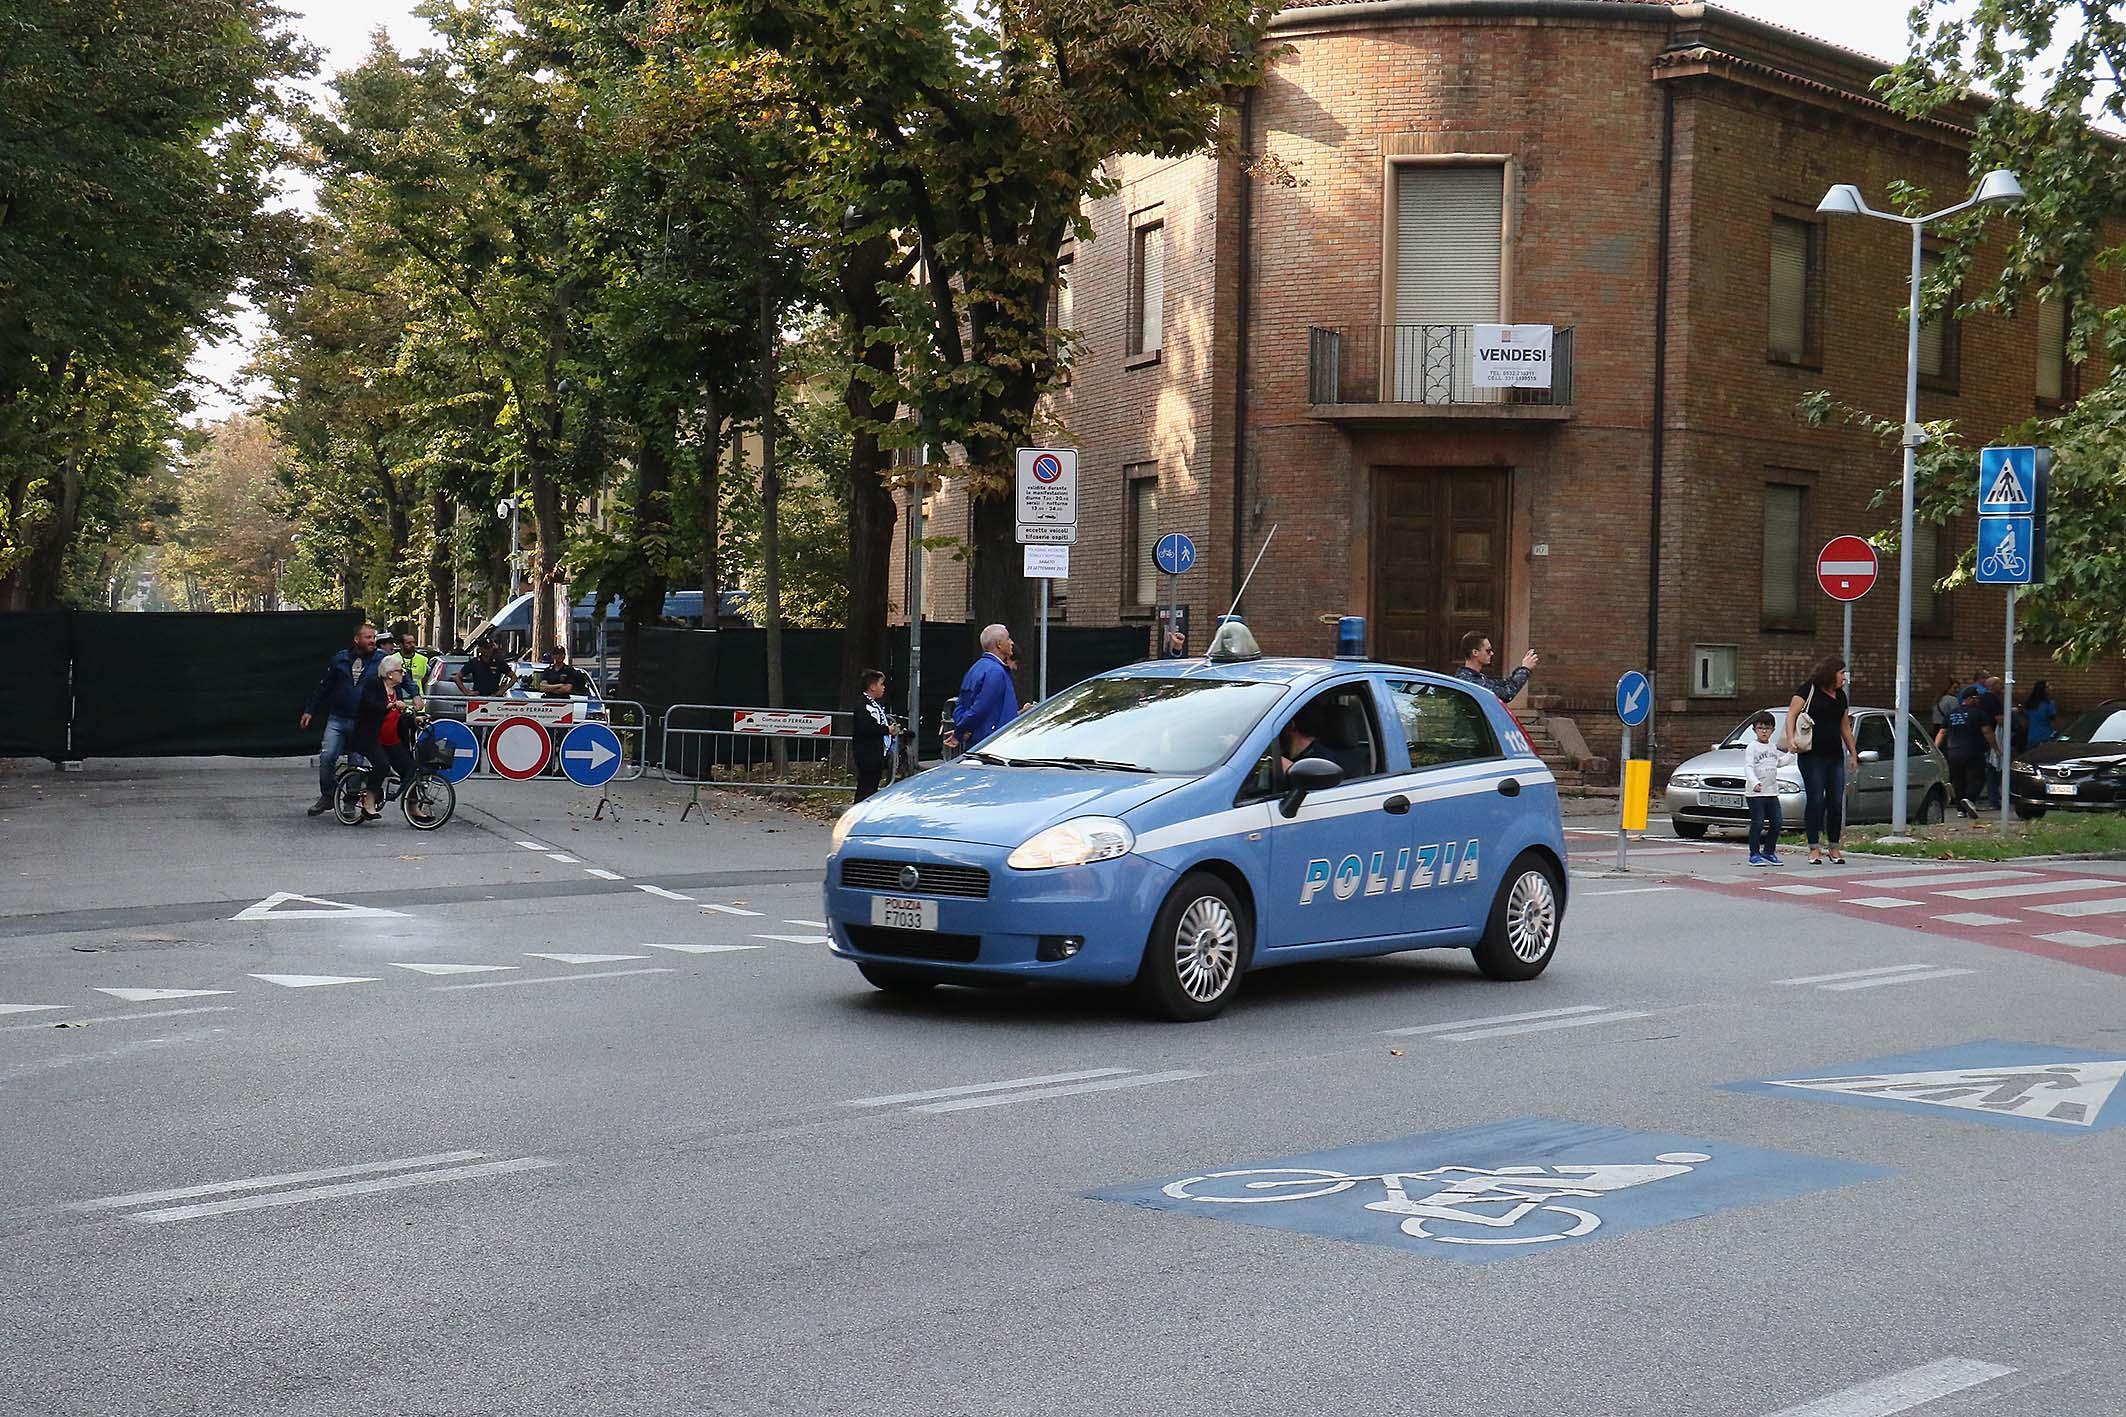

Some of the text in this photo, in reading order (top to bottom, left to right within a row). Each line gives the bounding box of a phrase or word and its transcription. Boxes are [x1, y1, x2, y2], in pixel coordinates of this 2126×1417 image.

[1479, 348, 1546, 361] VENDESI
[1504, 730, 1529, 752] 113
[1299, 838, 1480, 906] POLIZIA
[885, 898, 922, 910] POLIZIA
[885, 910, 922, 928] F7033
